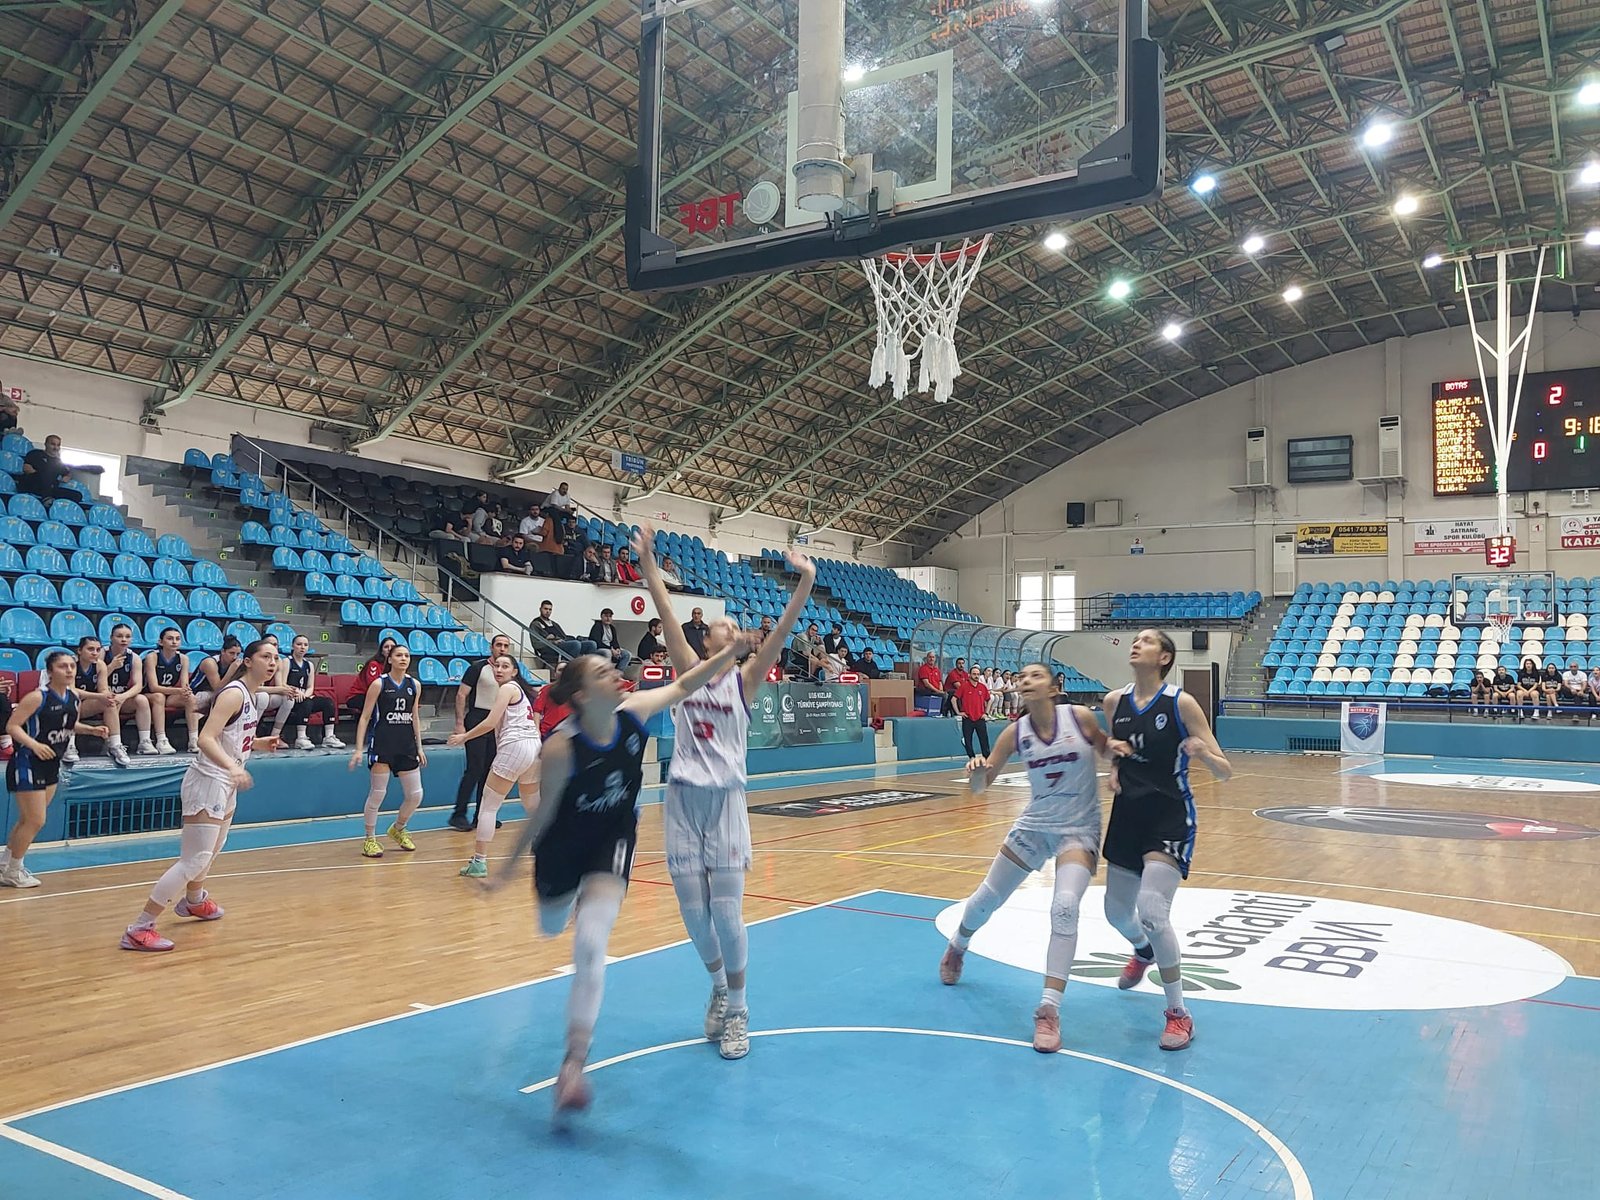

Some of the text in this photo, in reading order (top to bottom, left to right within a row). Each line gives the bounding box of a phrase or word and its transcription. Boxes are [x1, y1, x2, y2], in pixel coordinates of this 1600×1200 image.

[1549, 386, 1562, 405] 2
[1534, 442, 1546, 459] 0
[112, 673, 119, 685] 8
[161, 673, 173, 685] 12
[395, 697, 406, 711] 13
[1044, 771, 1065, 788] 7
[1181, 893, 1317, 960] Garanti
[1263, 920, 1393, 978] BBVA
